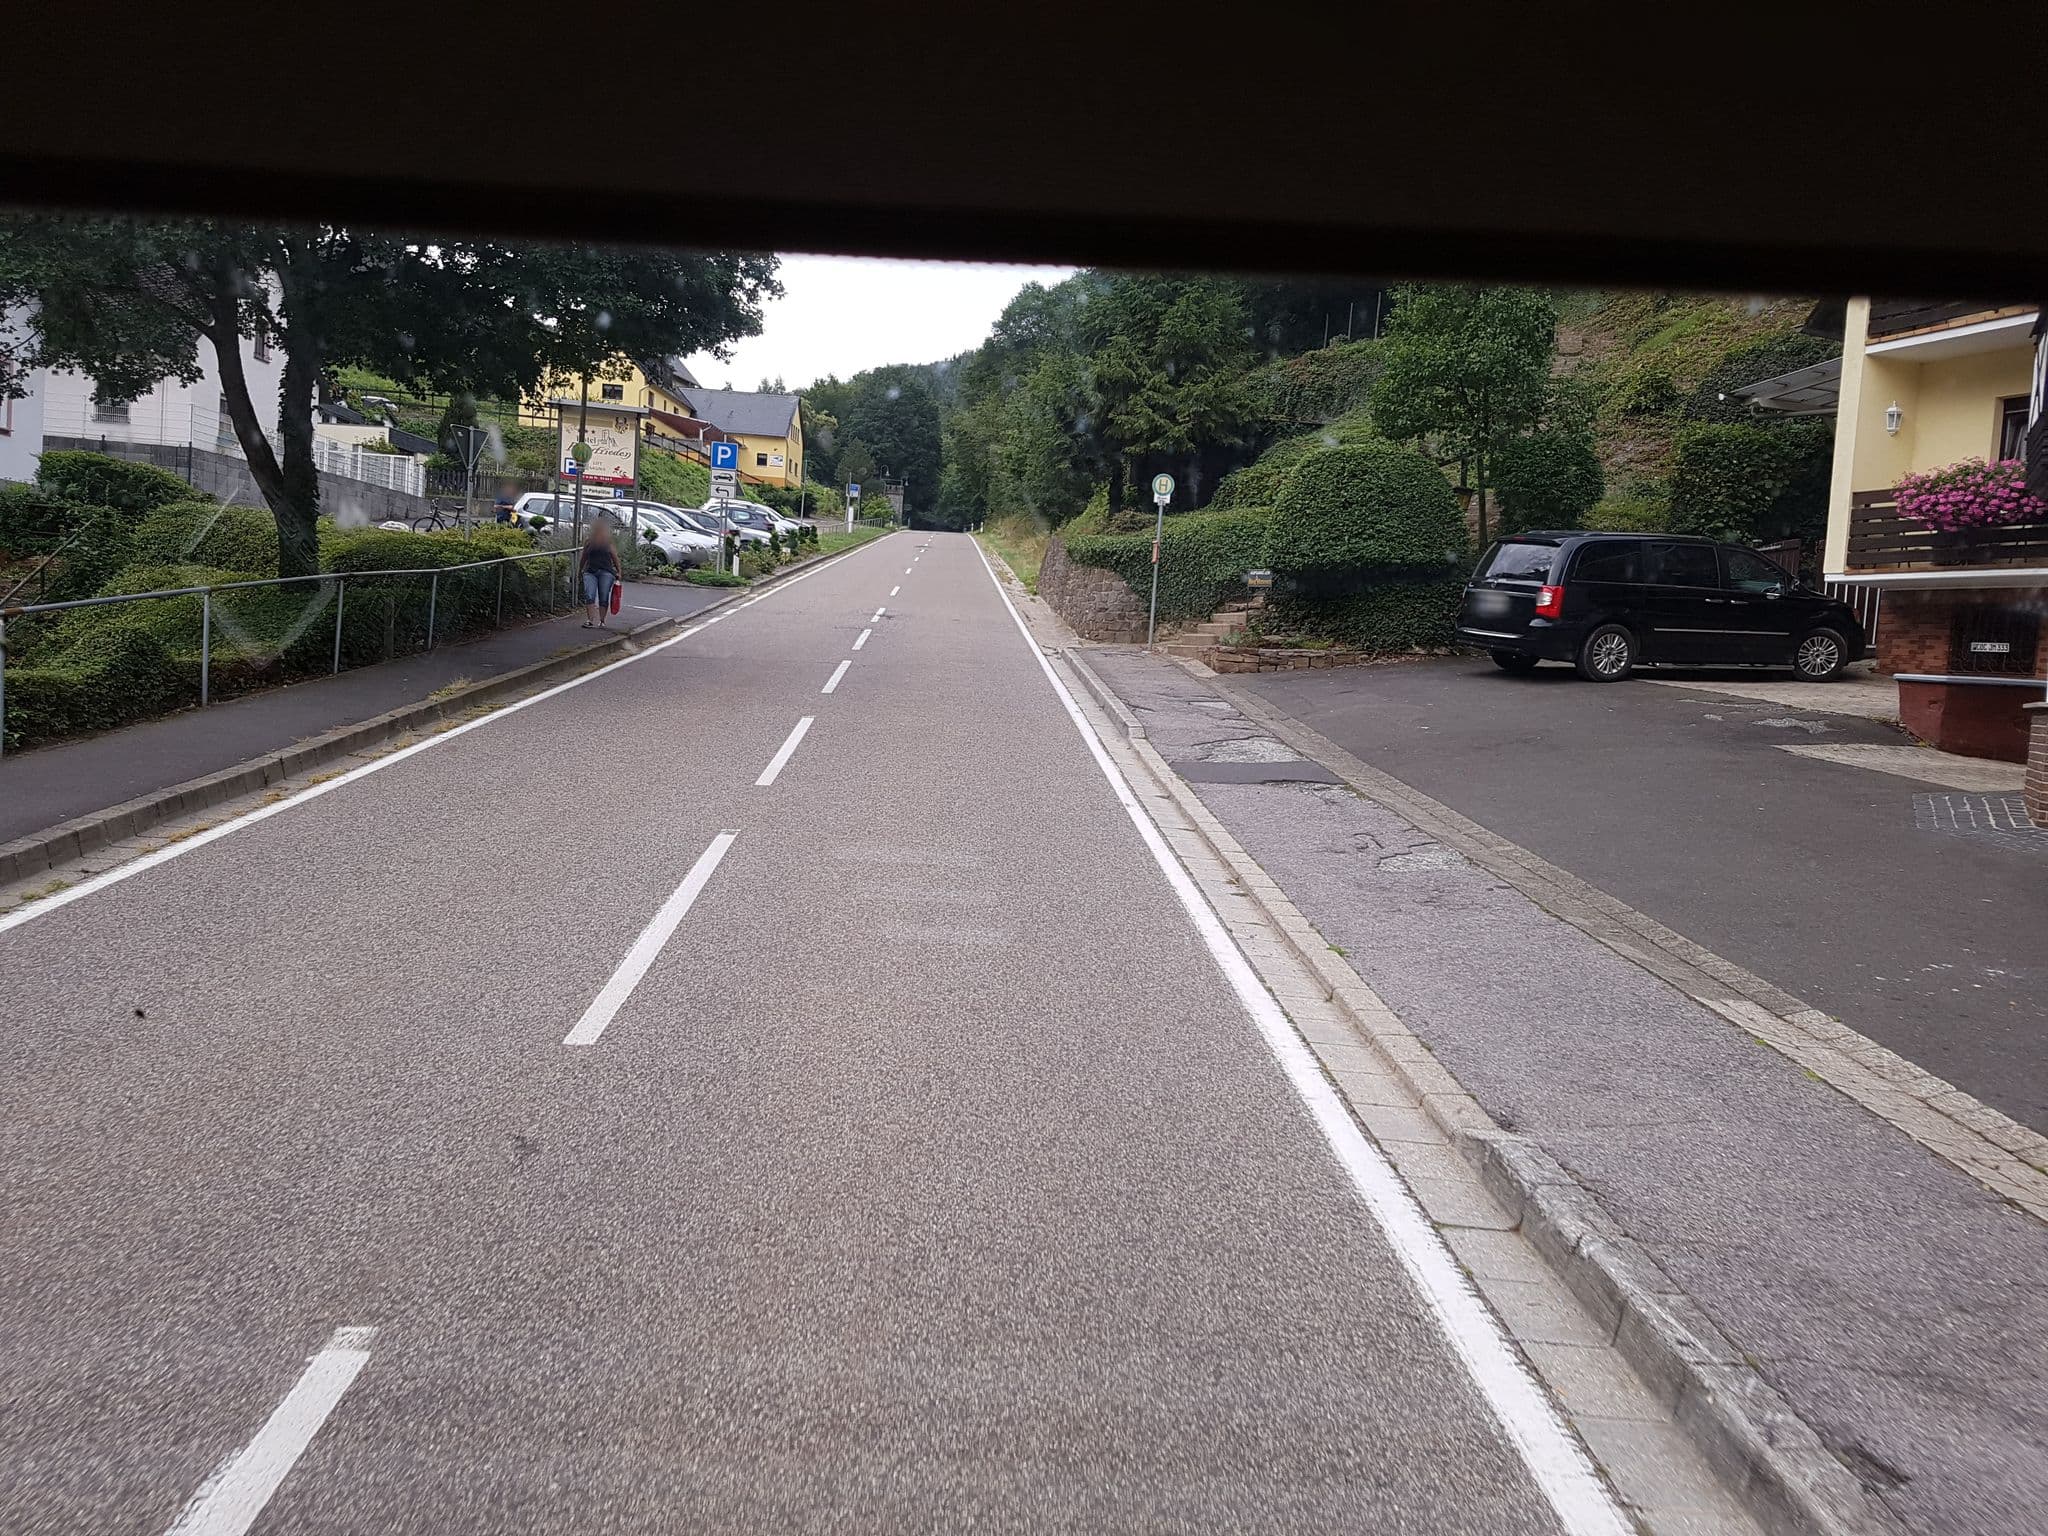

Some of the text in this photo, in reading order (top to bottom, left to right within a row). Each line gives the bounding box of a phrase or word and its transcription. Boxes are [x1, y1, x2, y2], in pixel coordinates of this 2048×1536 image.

[577, 434, 597, 444] tel
[566, 441, 632, 459] frieden
[717, 446, 731, 465] P
[1159, 480, 1168, 491] H
